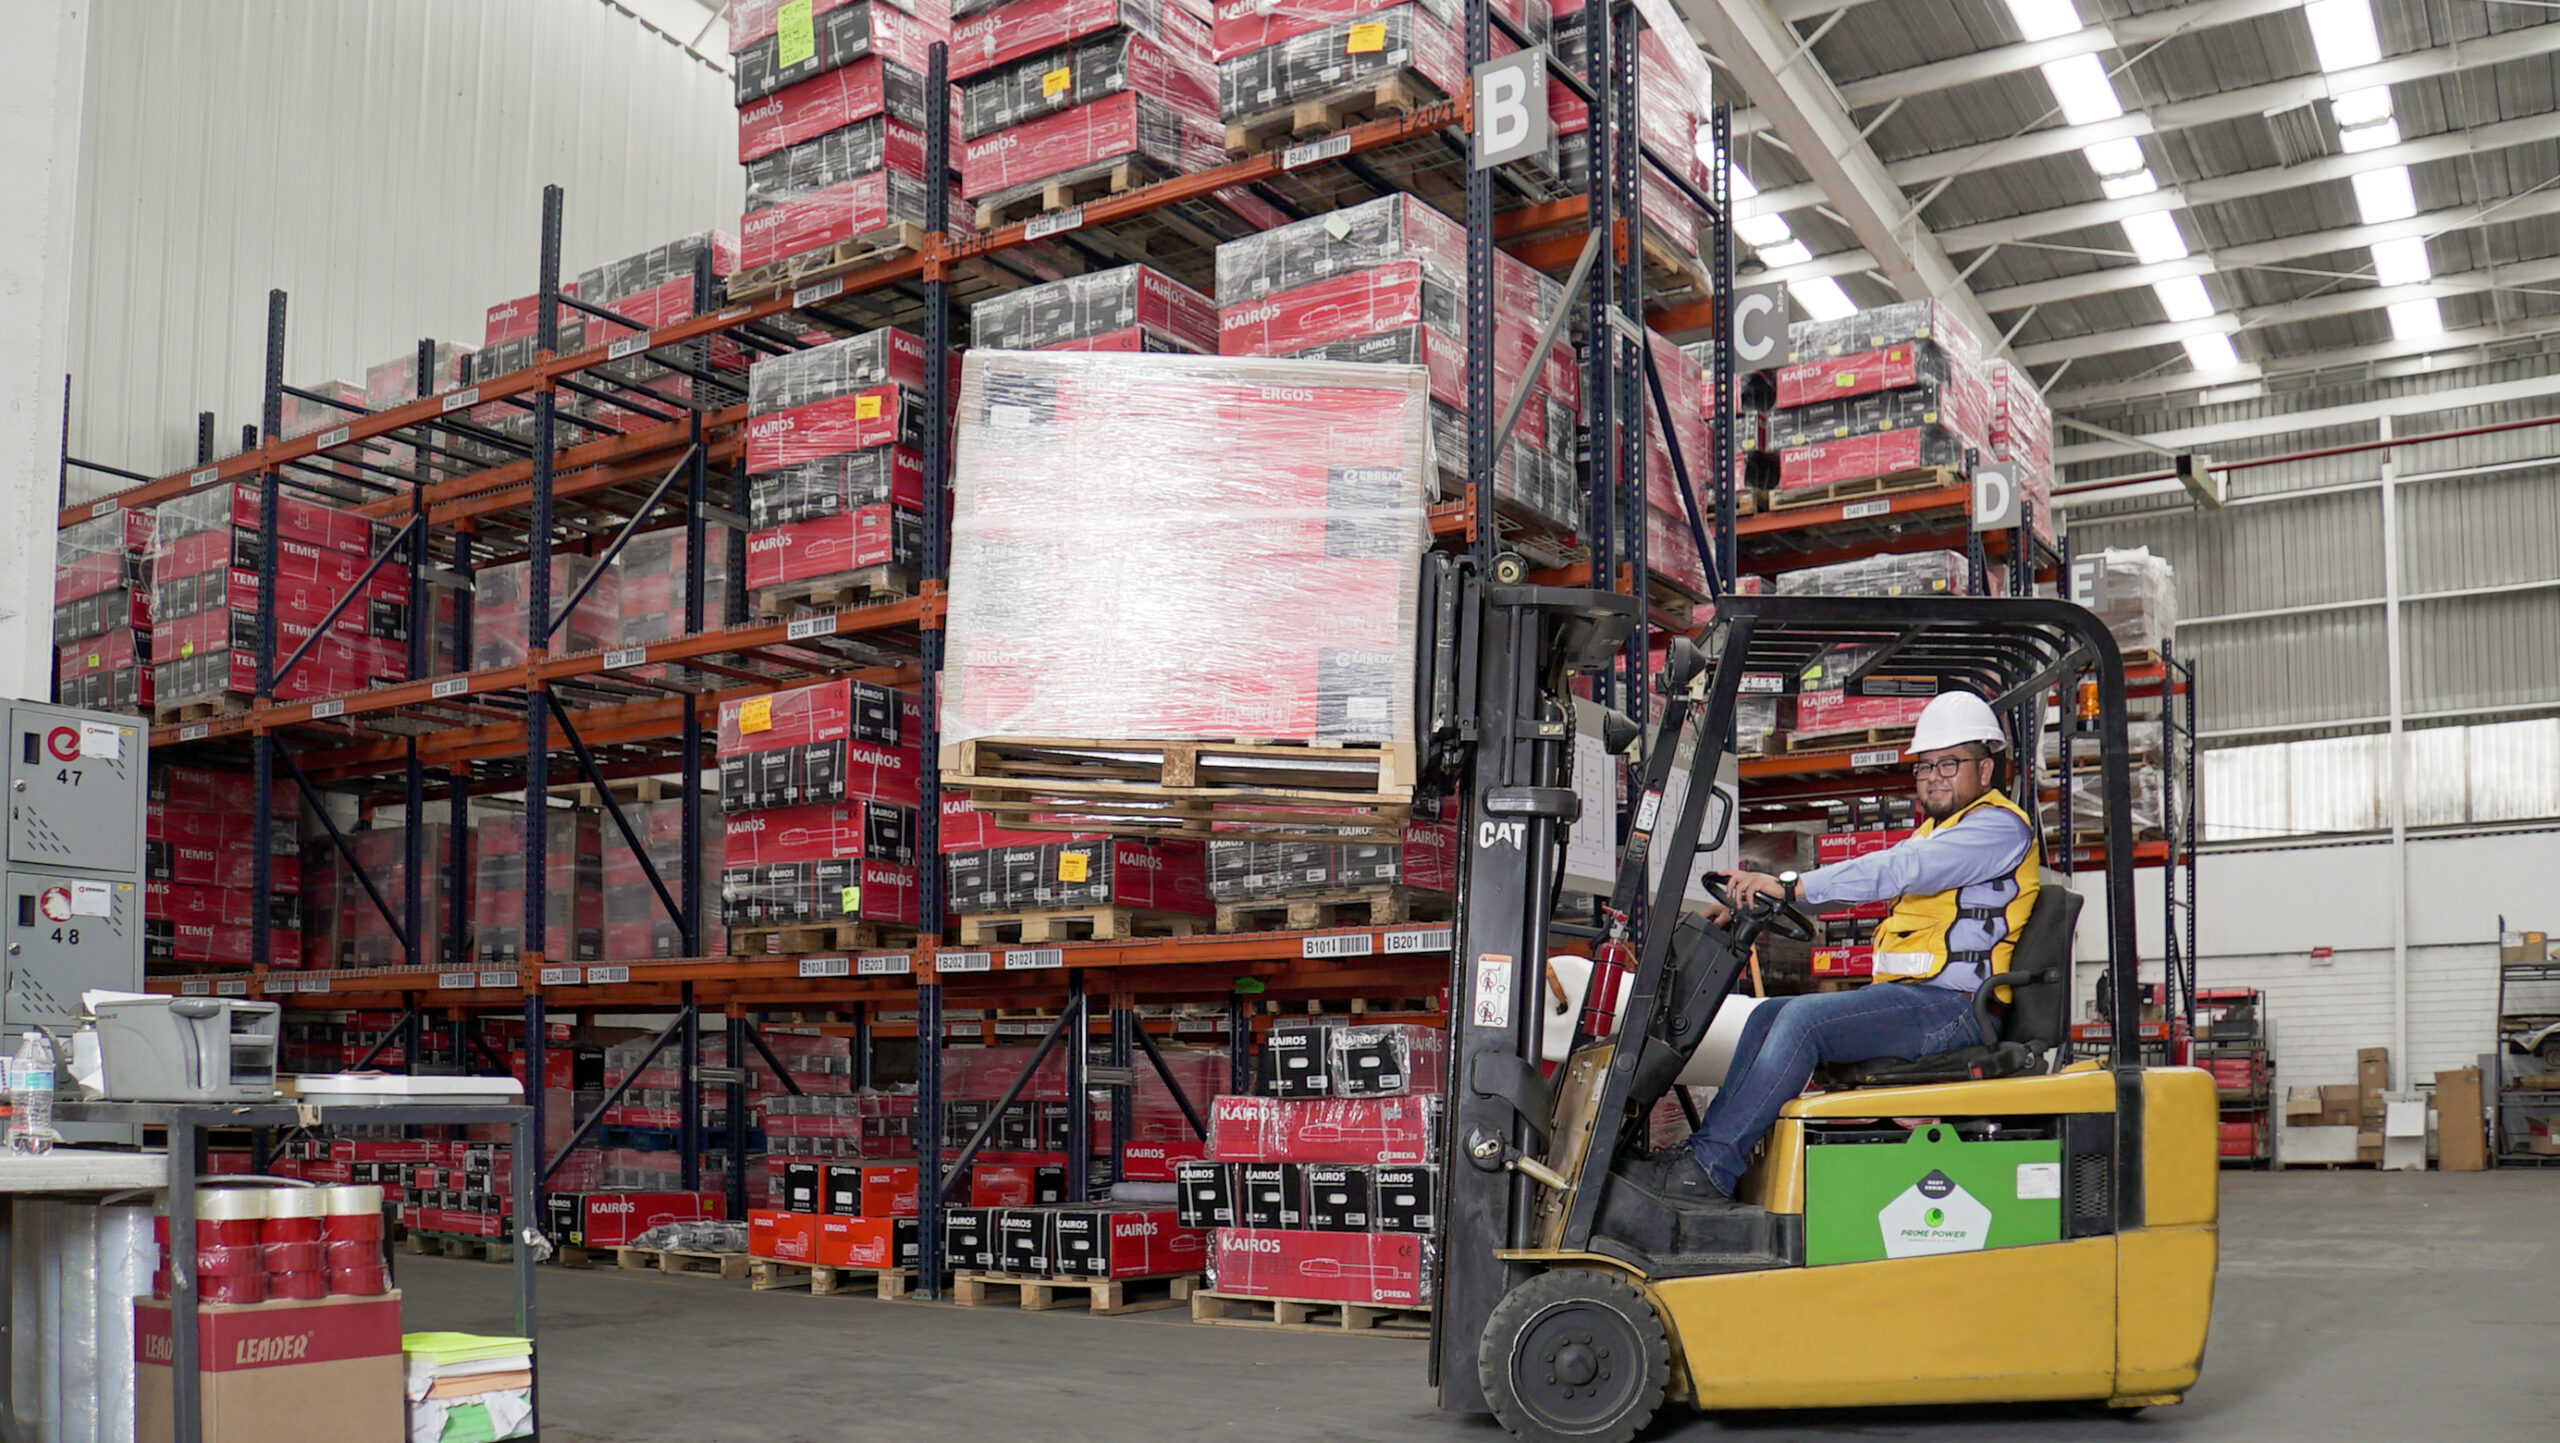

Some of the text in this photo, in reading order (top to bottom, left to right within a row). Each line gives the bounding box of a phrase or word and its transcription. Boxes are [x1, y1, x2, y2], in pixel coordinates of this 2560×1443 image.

[953, 16, 1002, 42] KAIROS
[741, 102, 784, 126] KAIROS
[1482, 65, 1530, 155] B
[888, 124, 926, 146] KAIRO
[967, 134, 1017, 160] KAIROS
[1289, 148, 1313, 165] B401
[745, 210, 787, 234] KAIROS
[1144, 275, 1186, 307] KAIROS
[1224, 303, 1281, 331] KAIROS
[1734, 293, 1775, 361] C
[895, 336, 925, 359] KAIR
[1359, 336, 1396, 354] KAIROS
[1782, 366, 1822, 382] KAIROS
[1261, 389, 1313, 401] ERGOS
[751, 416, 794, 438] KAIROS
[1785, 449, 1826, 463] KAIROS
[238, 488, 261, 501] TEM
[1976, 472, 2010, 524] D
[282, 541, 318, 558] TEMIS
[750, 534, 793, 553] KAIROS
[232, 571, 259, 585] TEM
[2071, 562, 2095, 608] E
[791, 622, 809, 636] B303
[853, 687, 884, 701] KAIROS
[1802, 695, 1843, 708] KAIROS
[853, 748, 901, 769] KAIROS
[1854, 754, 1872, 765] D301
[57, 768, 83, 787] 47
[870, 807, 898, 819] KAIROS
[943, 800, 974, 815] KAIR
[727, 819, 766, 834] KAIROS
[1407, 828, 1445, 847] KAIROS
[1479, 821, 1525, 850] CAT
[1821, 837, 1856, 847] KAIROS
[179, 848, 213, 861] TEMIS
[1004, 852, 1035, 864] KAIROS
[1119, 851, 1162, 870] KAIROS
[949, 857, 979, 869] KAIROS
[867, 870, 913, 887] KAIROS
[51, 928, 80, 945] 48
[179, 925, 213, 937] TEMIS
[1307, 940, 1330, 954] B101
[1393, 936, 1418, 949] B201
[864, 960, 883, 971] B203
[943, 957, 962, 968] B202
[1268, 1035, 1307, 1046] KAIROS
[1220, 1106, 1279, 1121] KAIROS
[1126, 1148, 1165, 1159] KAIROS
[1180, 1169, 1214, 1179] KAIROS
[1246, 1170, 1280, 1181] KAIROS
[1311, 1171, 1346, 1182] KAIROS
[1377, 1172, 1413, 1183] KAIROS
[591, 1202, 635, 1214] KAIROS
[824, 1223, 847, 1232] ERGOS
[947, 1216, 976, 1226] KAIROS
[1001, 1218, 1032, 1229] KAIROS
[1058, 1219, 1088, 1229] KAIROS
[1116, 1222, 1158, 1237] KAIROS
[1901, 1229, 1966, 1238] PRIME POWER
[1222, 1238, 1281, 1253] KAIROS
[1398, 1245, 1411, 1256] CE
[1384, 1290, 1411, 1298] ERREKA
[145, 1334, 172, 1359] LEAD
